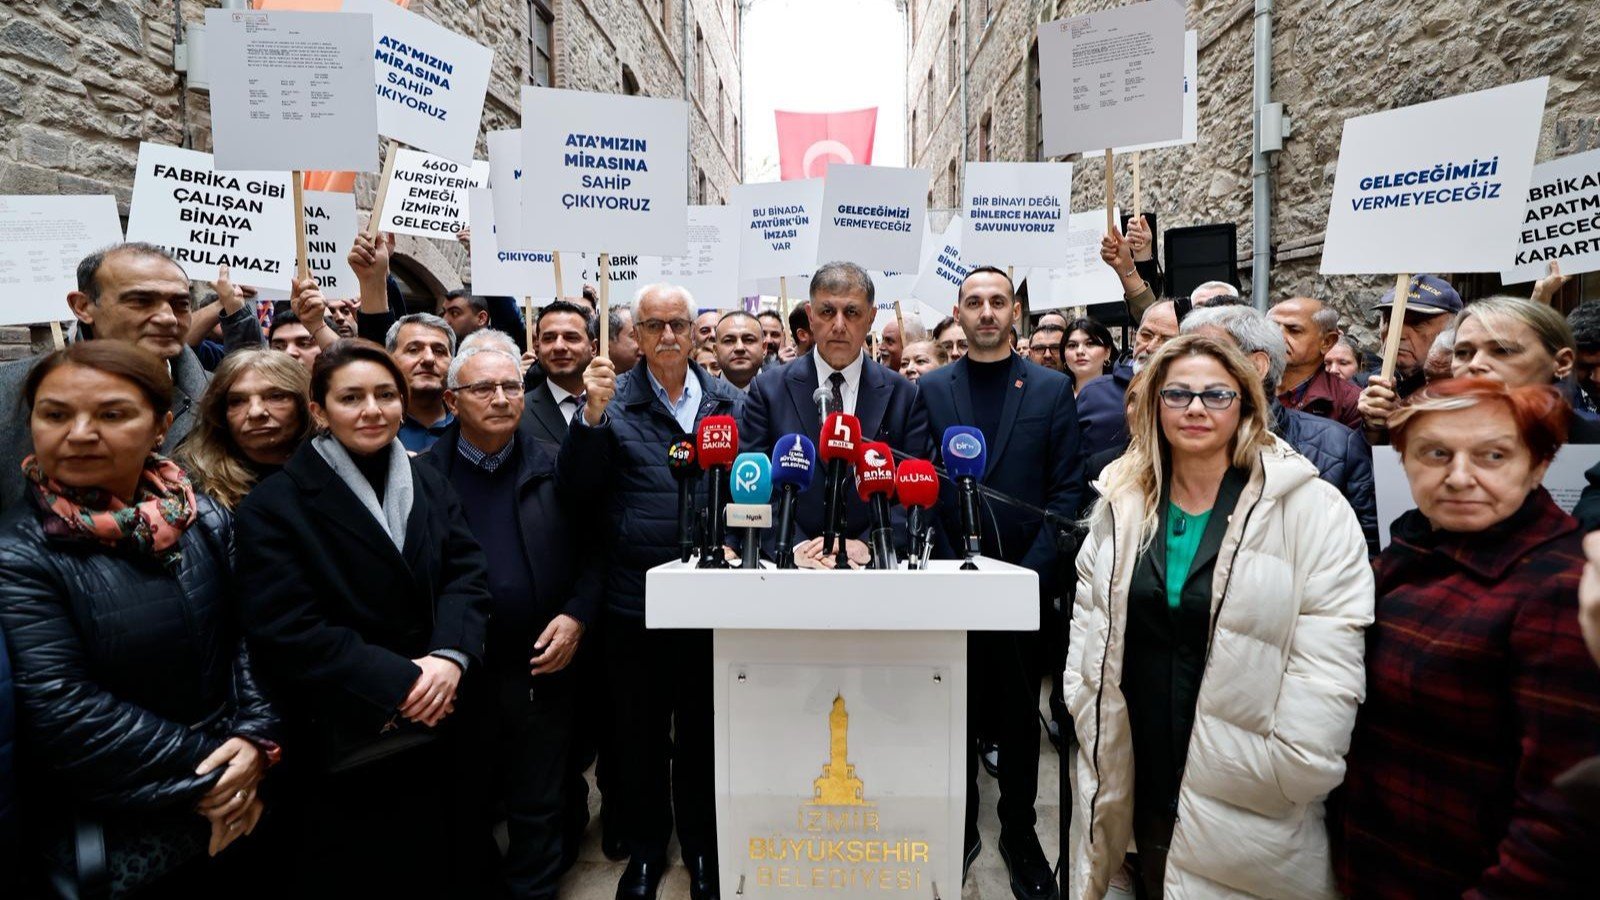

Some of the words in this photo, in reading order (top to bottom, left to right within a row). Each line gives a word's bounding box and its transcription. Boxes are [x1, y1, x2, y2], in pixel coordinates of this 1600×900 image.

[379, 35, 453, 75] ATA'MIZIN
[375, 49, 450, 90] MİRASINA
[387, 72, 433, 96] SAHİP
[376, 84, 447, 121] IKIYORUZ
[565, 133, 647, 152] ATA'MIZIN
[422, 159, 458, 173] 4600
[564, 150, 648, 172] MİRASINA
[153, 164, 241, 191] FABRİKA
[246, 180, 286, 199] GİBİ
[394, 169, 479, 190] KURSİYERİN
[581, 173, 631, 190] SAHİP
[1359, 155, 1499, 191] GELECEĞİMİZİ
[408, 186, 458, 204] EMEĞİ,
[1351, 181, 1502, 211] VERMEYECEĞİZ
[1526, 171, 1600, 203] BRİKA
[173, 187, 264, 214] ÇALIŞAN
[401, 198, 459, 218] İZMİR'İN
[561, 193, 650, 212] ÇIKIYORUZ
[972, 194, 989, 206] BİR
[991, 194, 1025, 206] BİNAYI
[1028, 195, 1061, 207] DEĞİL
[1523, 194, 1600, 224] APATM
[179, 207, 253, 231] BİNAYA
[752, 208, 766, 217] BU
[768, 204, 805, 216] BİNADA
[837, 204, 910, 219] GELECEĞİMİZİ
[970, 207, 1021, 219] BİNLERCE
[1023, 208, 1061, 220] HAYALİ
[750, 216, 809, 230] ATATÜRK'ÜN
[833, 217, 912, 232] VERMEYECEĞİZ
[974, 222, 1055, 233] SAVUNUYORUZ
[1519, 212, 1600, 244] ELECE
[189, 228, 240, 248] KİLİT
[764, 229, 797, 240] İMZASI
[772, 241, 791, 251] VAR
[943, 245, 959, 258] BİR
[157, 245, 280, 274] RULAMAZ!
[497, 251, 554, 263] ÇIKIYORU
[597, 254, 639, 267] BRİK
[702, 441, 731, 450] DAKIKA
[863, 467, 892, 478] anka
[900, 473, 934, 483] ULUSAL
